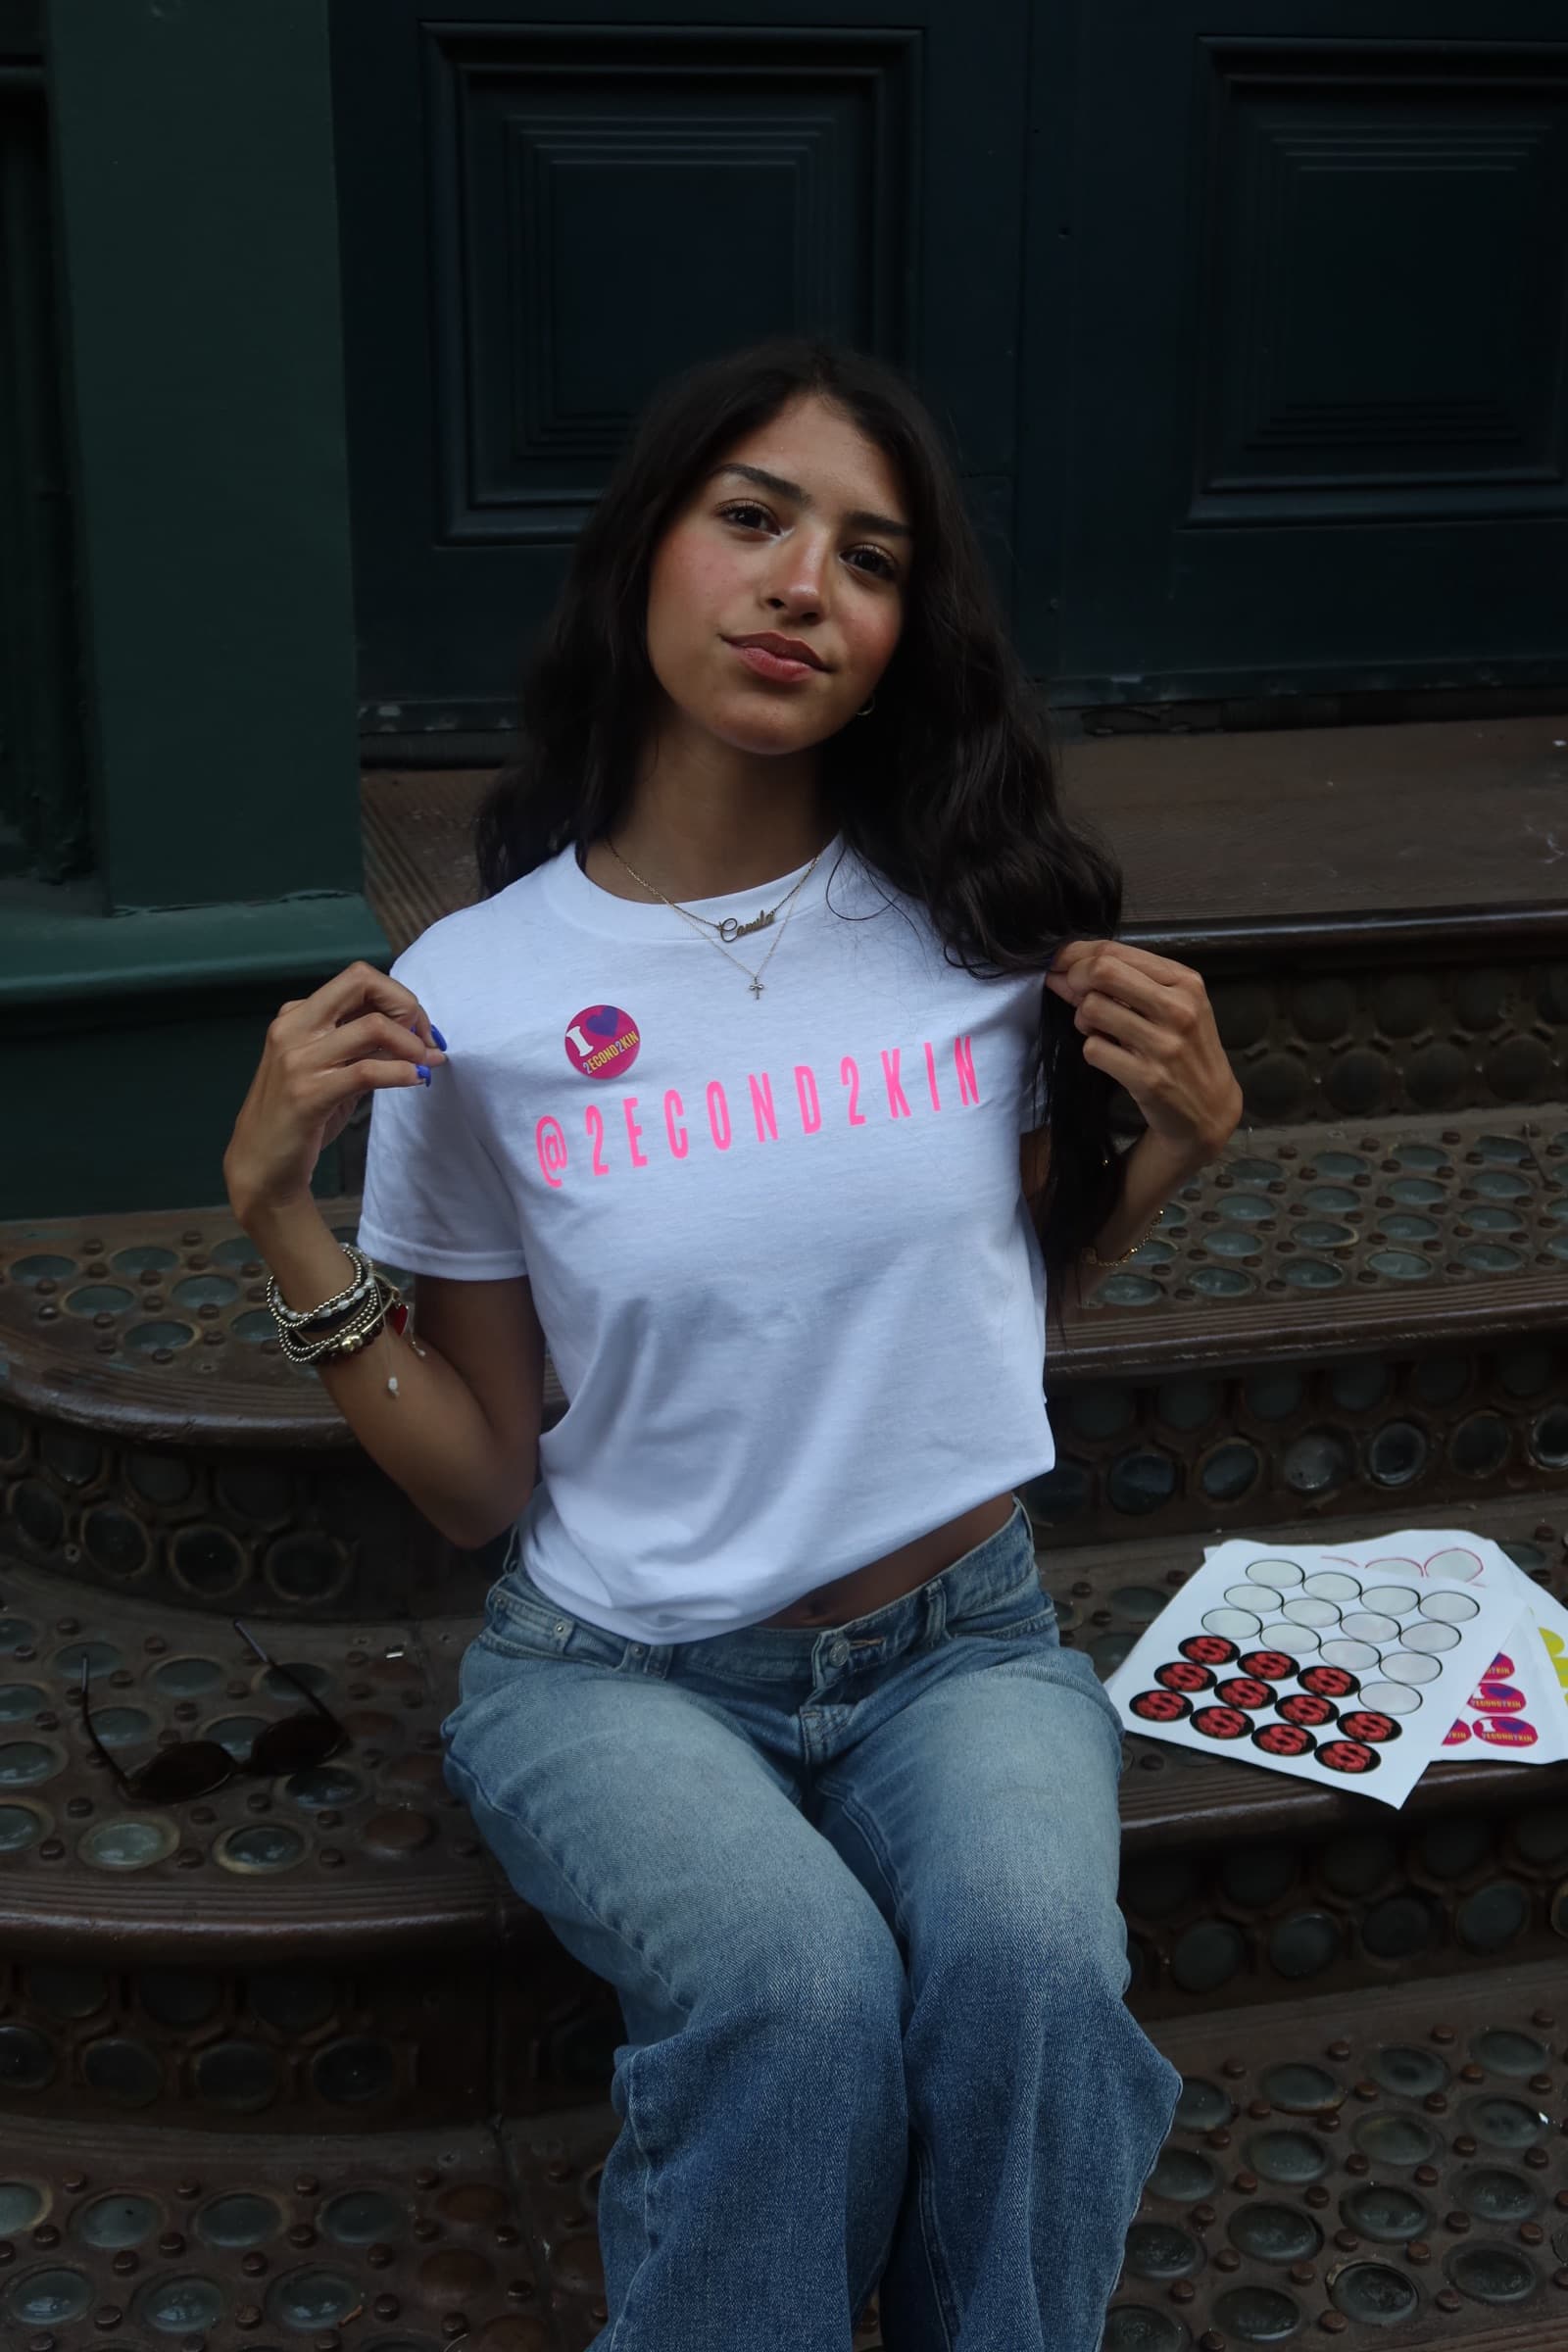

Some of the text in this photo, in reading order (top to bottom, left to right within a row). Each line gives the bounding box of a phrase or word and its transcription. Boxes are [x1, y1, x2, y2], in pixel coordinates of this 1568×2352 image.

[565, 1025, 594, 1056] I
[582, 1031, 639, 1075] 2ECOND2KIN
[536, 1035, 979, 1188] @2ECOND2KIN
